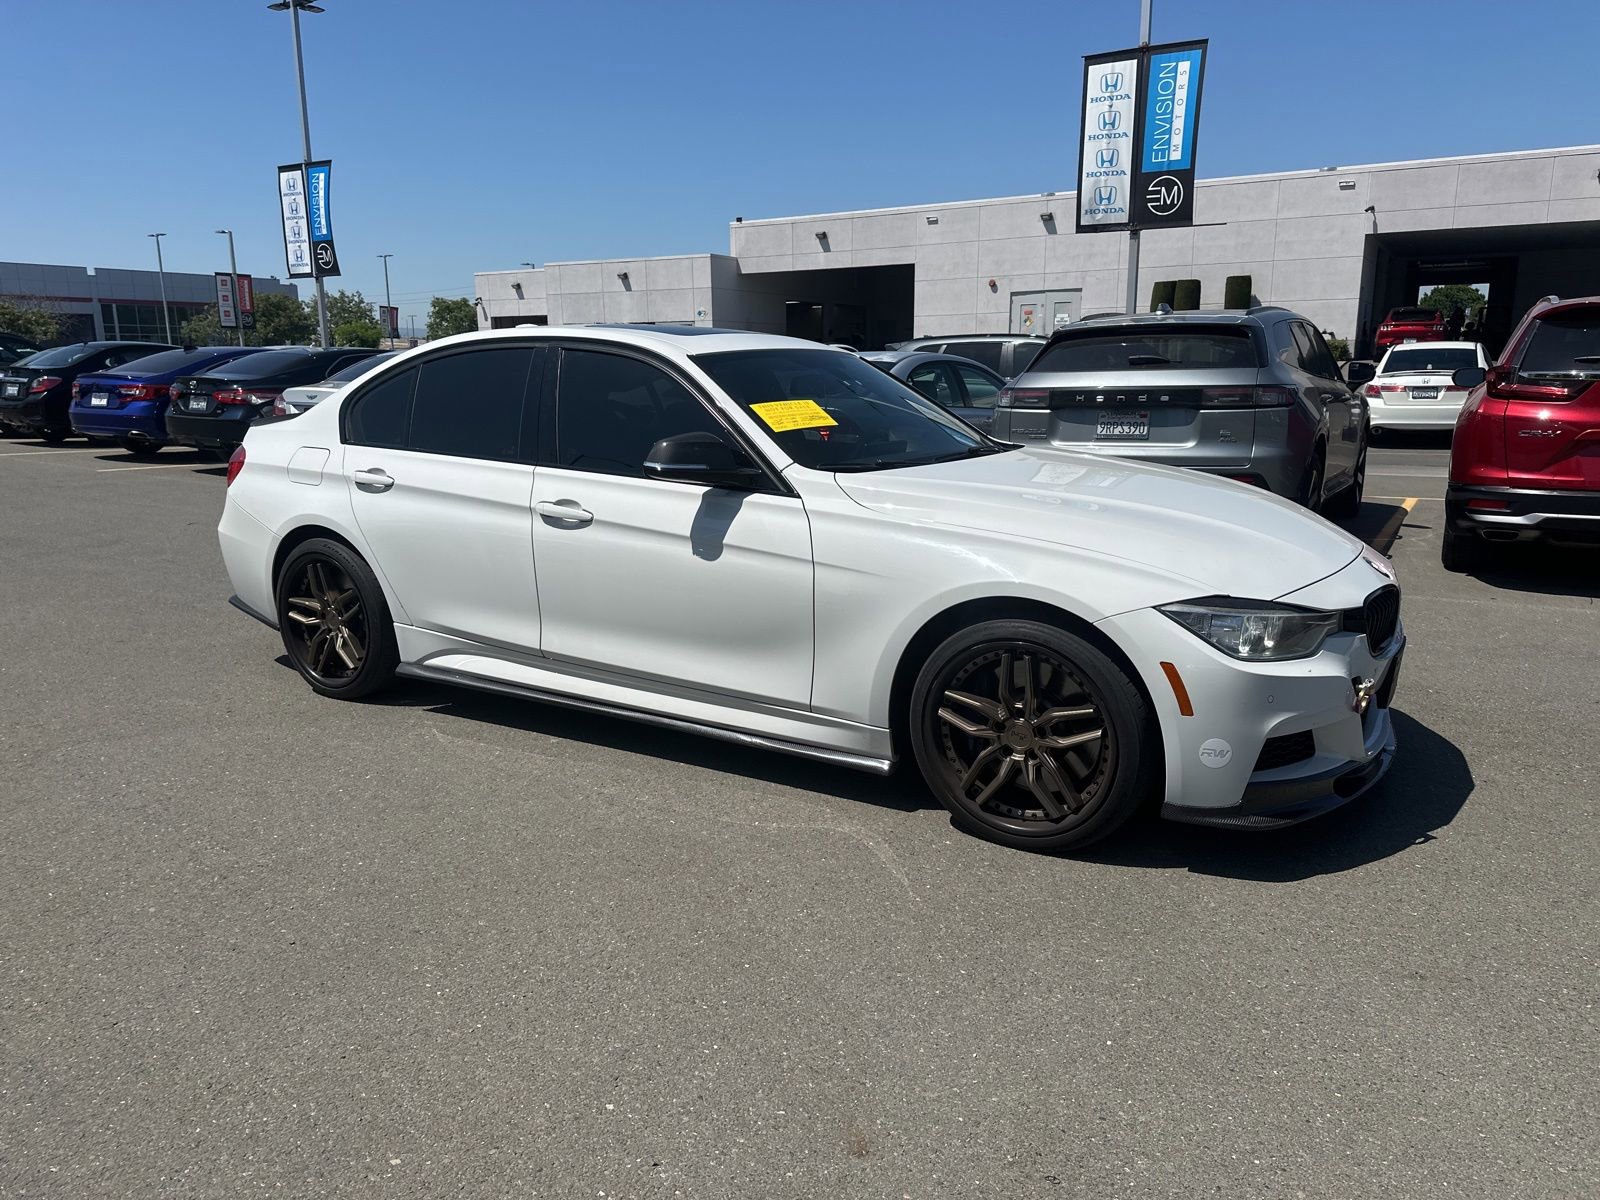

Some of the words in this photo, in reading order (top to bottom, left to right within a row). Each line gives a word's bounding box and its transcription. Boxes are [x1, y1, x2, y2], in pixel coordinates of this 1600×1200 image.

[1090, 93, 1132, 103] HONDA
[1152, 62, 1177, 163] ENVISION
[1172, 70, 1187, 152] MOTORS
[1088, 131, 1129, 141] HONDA
[1086, 169, 1127, 178] HONDA
[312, 173, 323, 236] ENVISION
[1084, 207, 1125, 215] HONDA
[1099, 421, 1146, 434] 9RPS390
